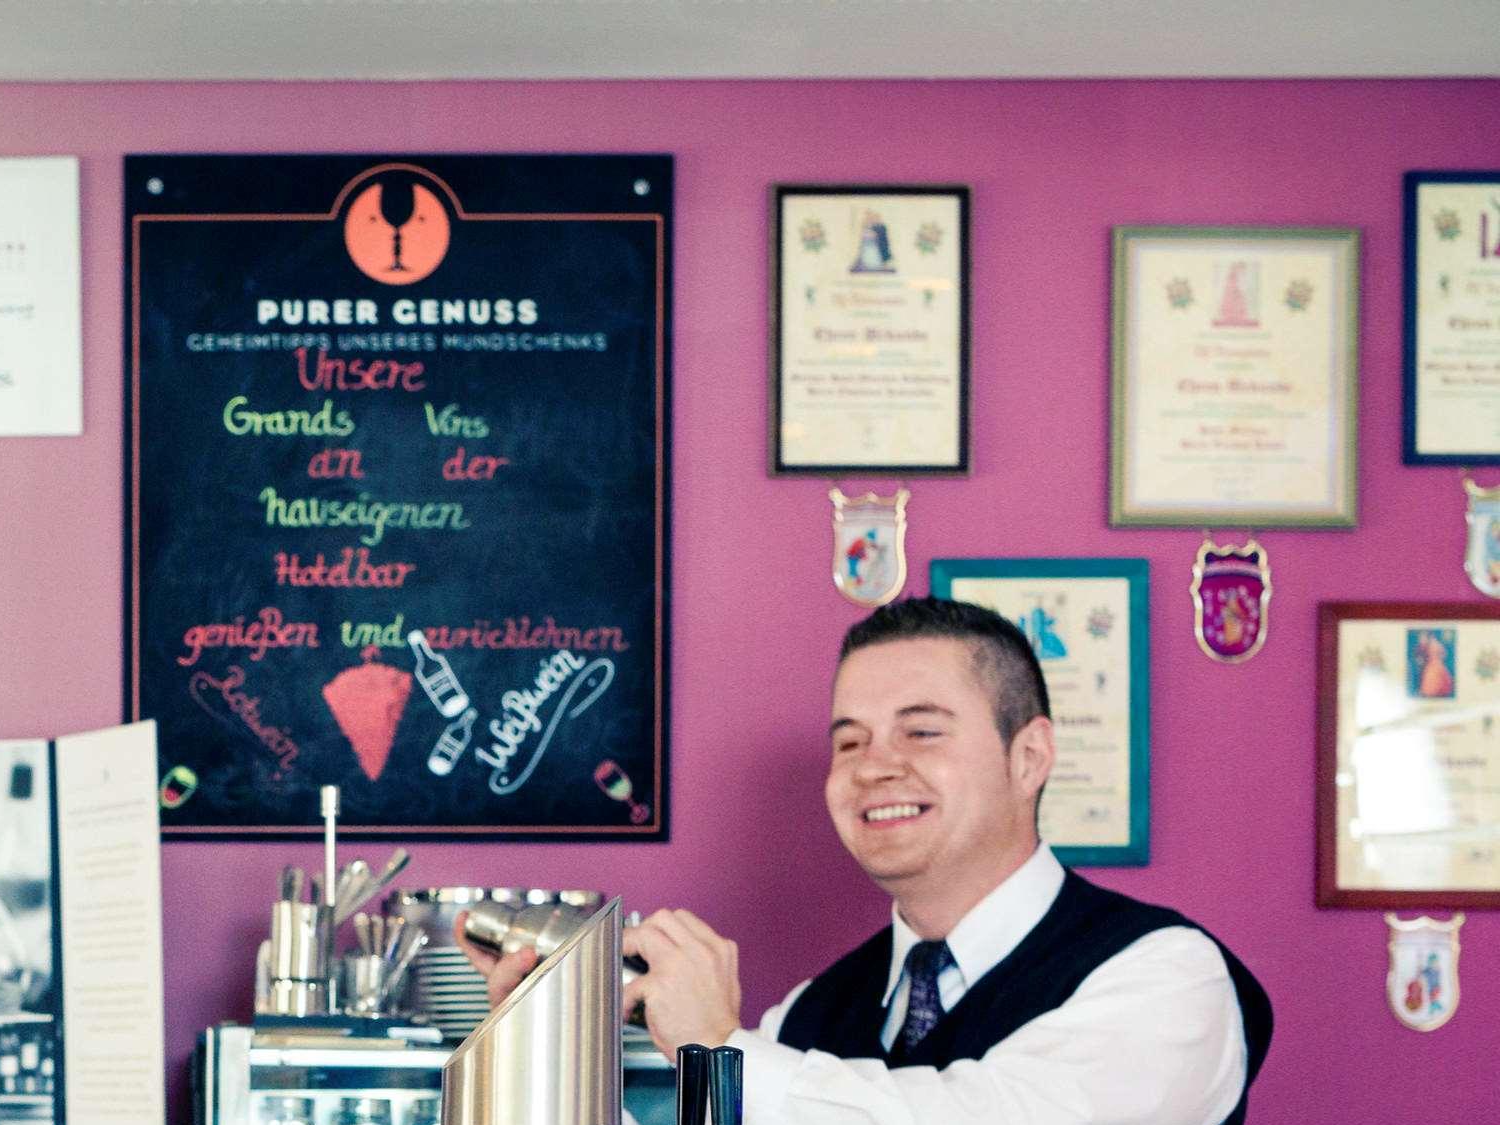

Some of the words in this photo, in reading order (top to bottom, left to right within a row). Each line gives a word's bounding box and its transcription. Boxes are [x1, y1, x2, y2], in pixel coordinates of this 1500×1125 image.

[257, 299, 378, 325] PURER
[392, 299, 539, 325] GENUSS
[337, 333, 437, 352] UNSERES
[295, 346, 426, 392] Unsere
[223, 396, 356, 437] Grands
[423, 401, 491, 439] Vins
[307, 447, 364, 480] an
[442, 445, 511, 481] der
[260, 488, 471, 545] hauseigenen
[273, 547, 417, 588] Hotelbar
[340, 612, 405, 649] und
